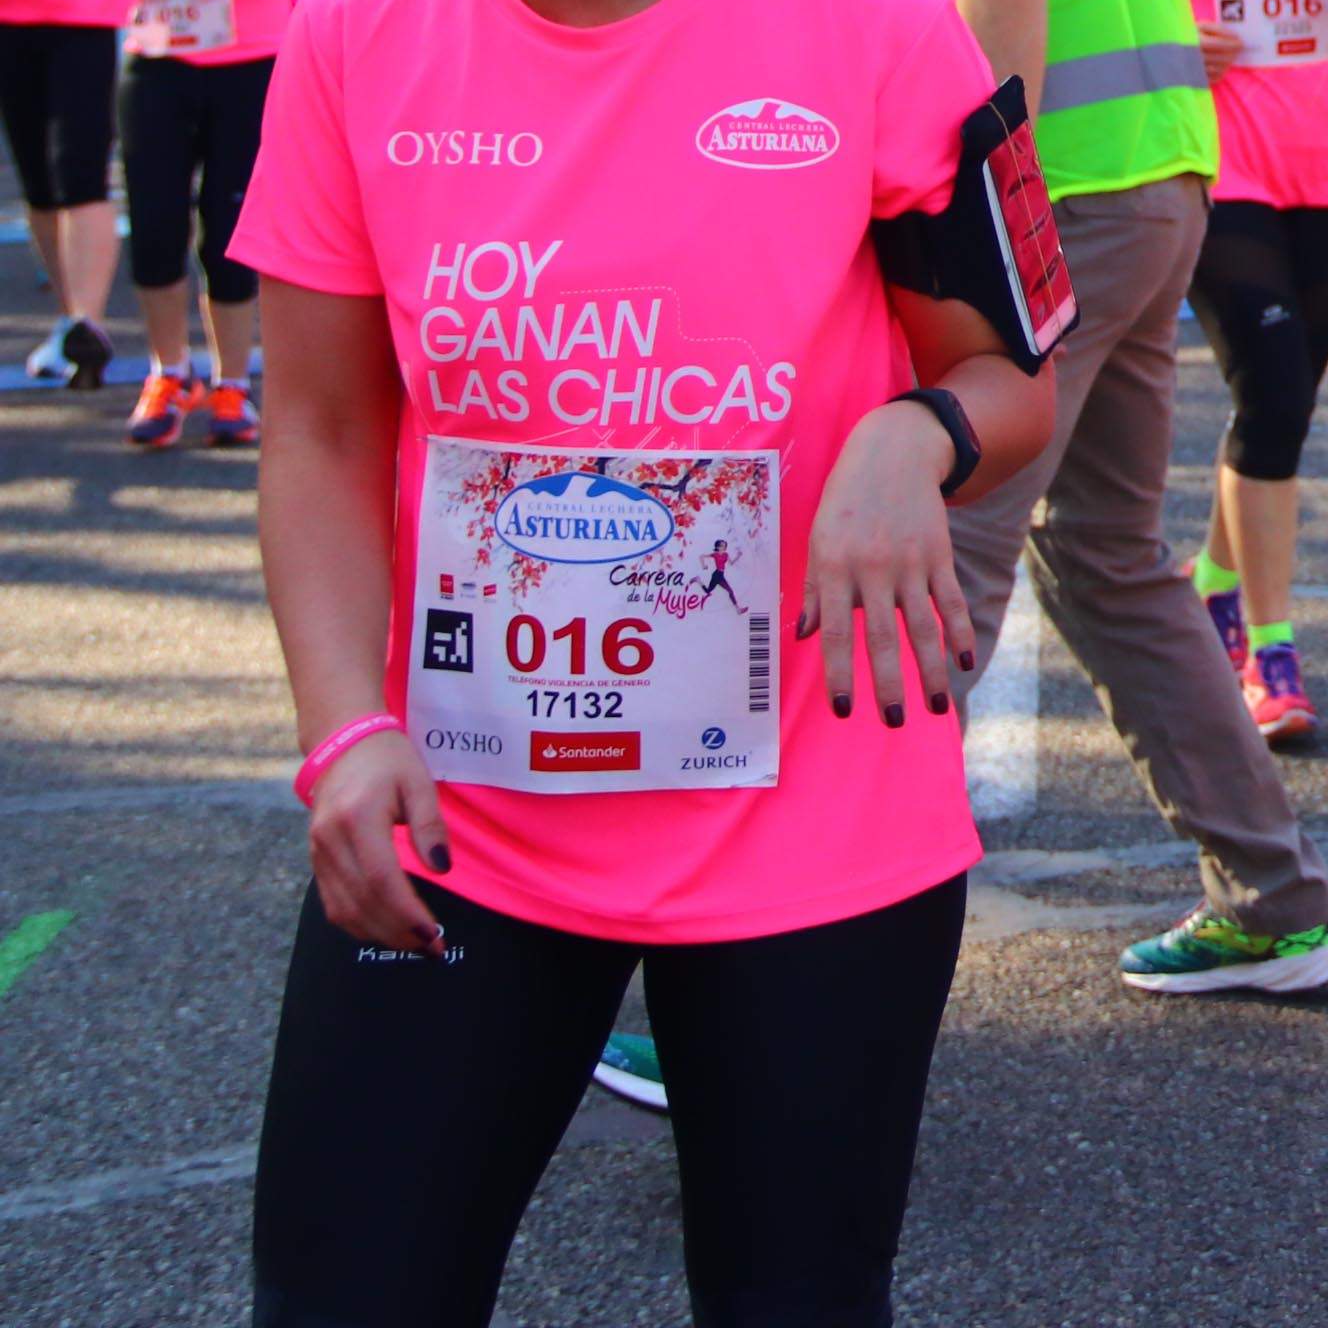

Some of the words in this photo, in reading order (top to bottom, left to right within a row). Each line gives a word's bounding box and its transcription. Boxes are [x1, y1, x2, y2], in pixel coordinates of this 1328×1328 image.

[387, 129, 544, 167] OYSHO
[706, 124, 829, 153] ASTURIANA
[423, 239, 564, 301] HOY
[420, 298, 662, 364] GANAN
[428, 367, 530, 423] LAS
[547, 361, 797, 427] CHICAS
[504, 502, 658, 542] ASTURIANA
[527, 501, 586, 513] CENTRAL
[609, 564, 685, 588] Carrera
[626, 589, 642, 603] de
[643, 589, 655, 603] la
[652, 585, 711, 619] Mujer
[505, 613, 655, 676] 016
[548, 677, 595, 688] VIOLENCIA
[597, 678, 609, 688] DE
[526, 689, 624, 719] 17132
[425, 727, 503, 755] OYSHO
[559, 745, 627, 759] Santander
[681, 754, 747, 770] ZURICH
